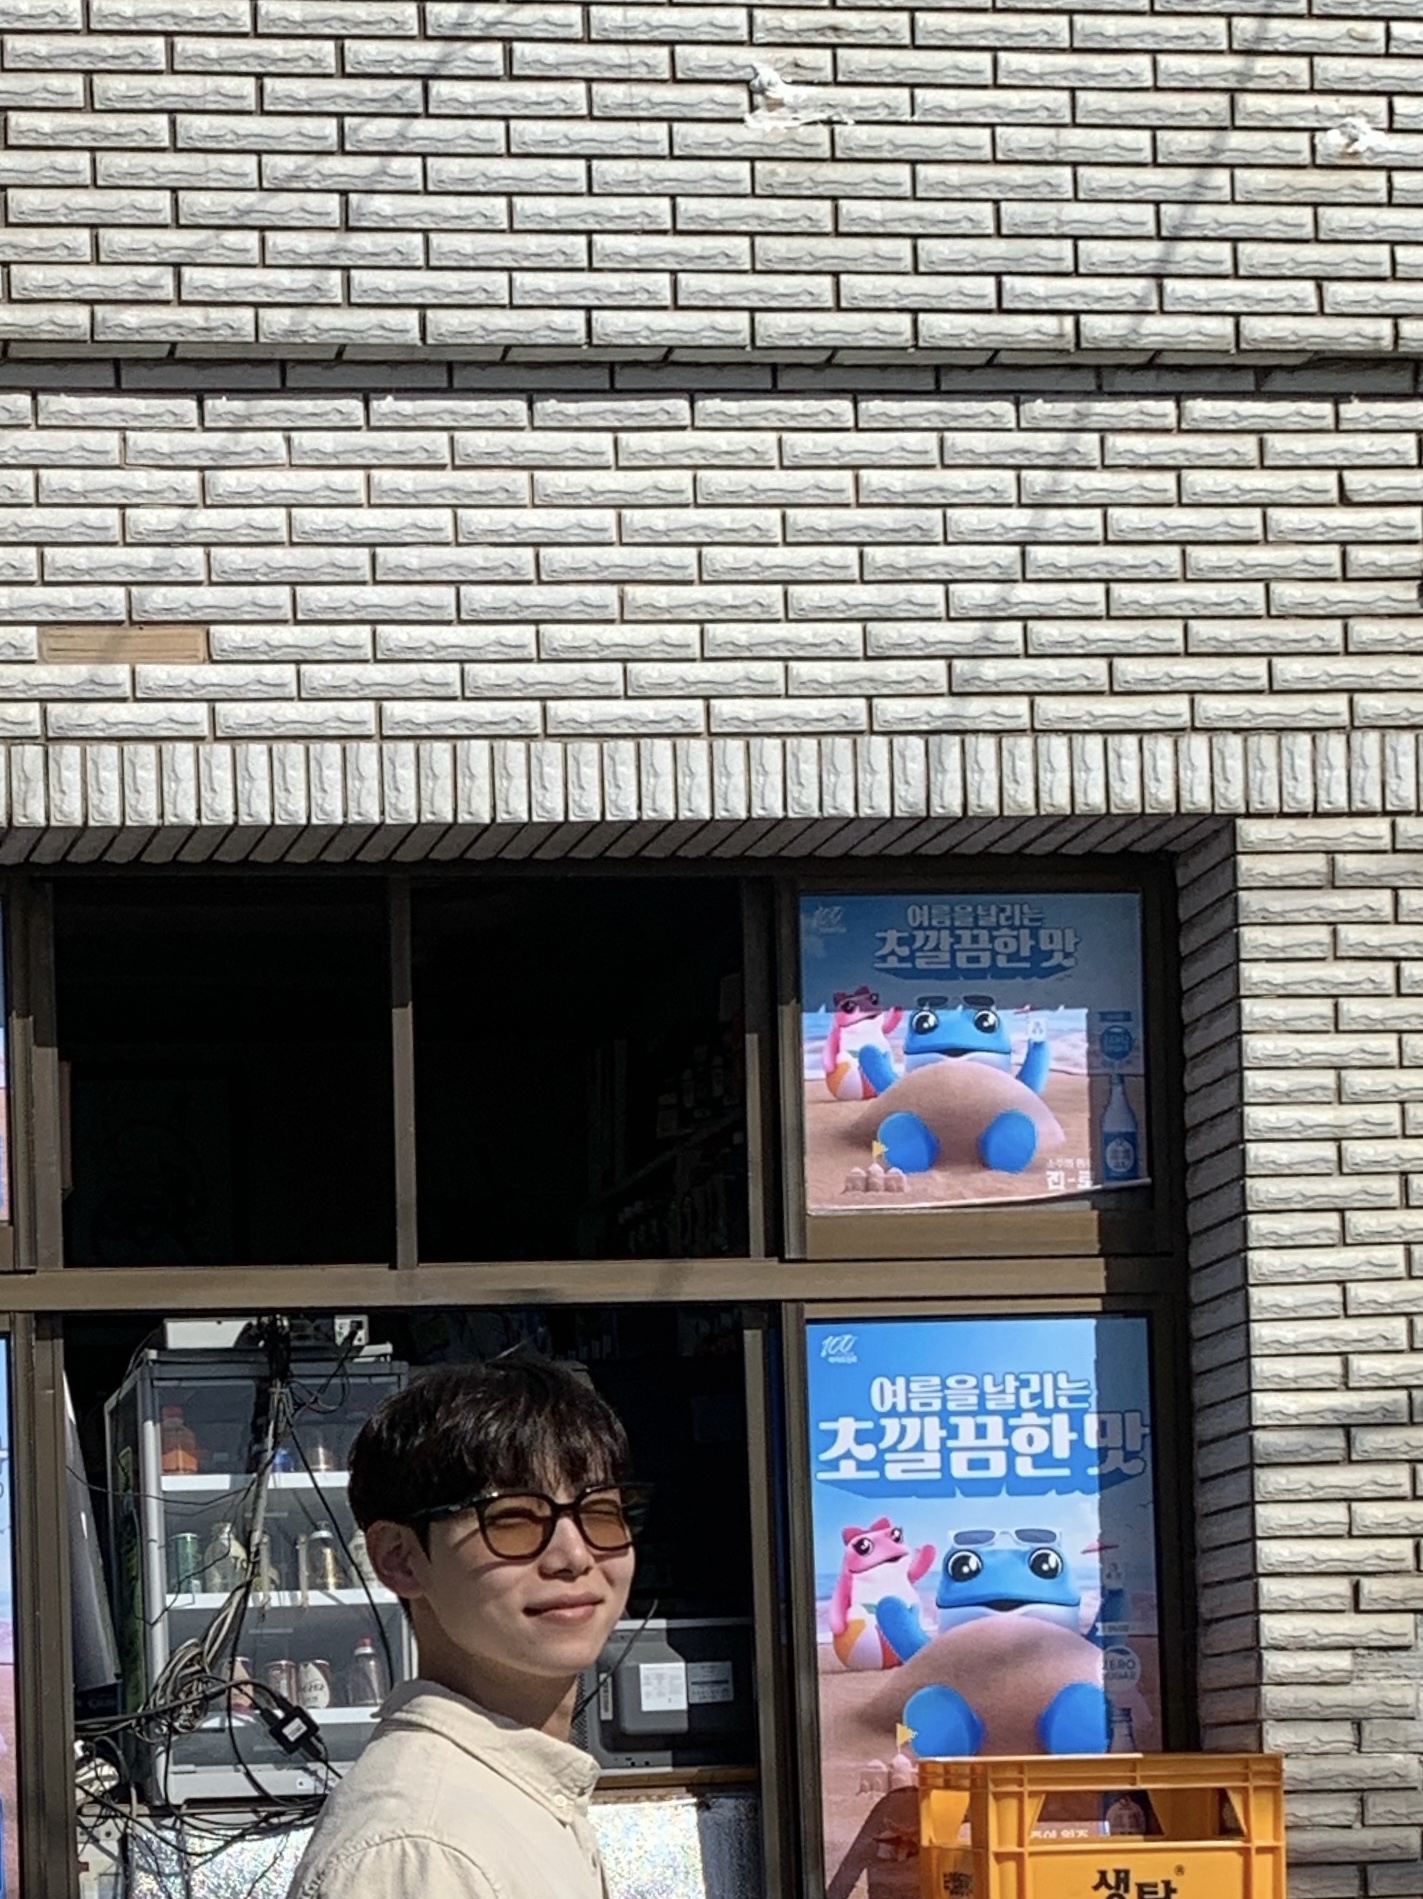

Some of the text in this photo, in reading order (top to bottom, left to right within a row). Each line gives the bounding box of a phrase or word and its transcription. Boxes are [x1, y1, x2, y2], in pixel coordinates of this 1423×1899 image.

[874, 927, 1080, 970] 초깔끔한 맛
[816, 1412, 1151, 1481] 초깔끔한 맛
